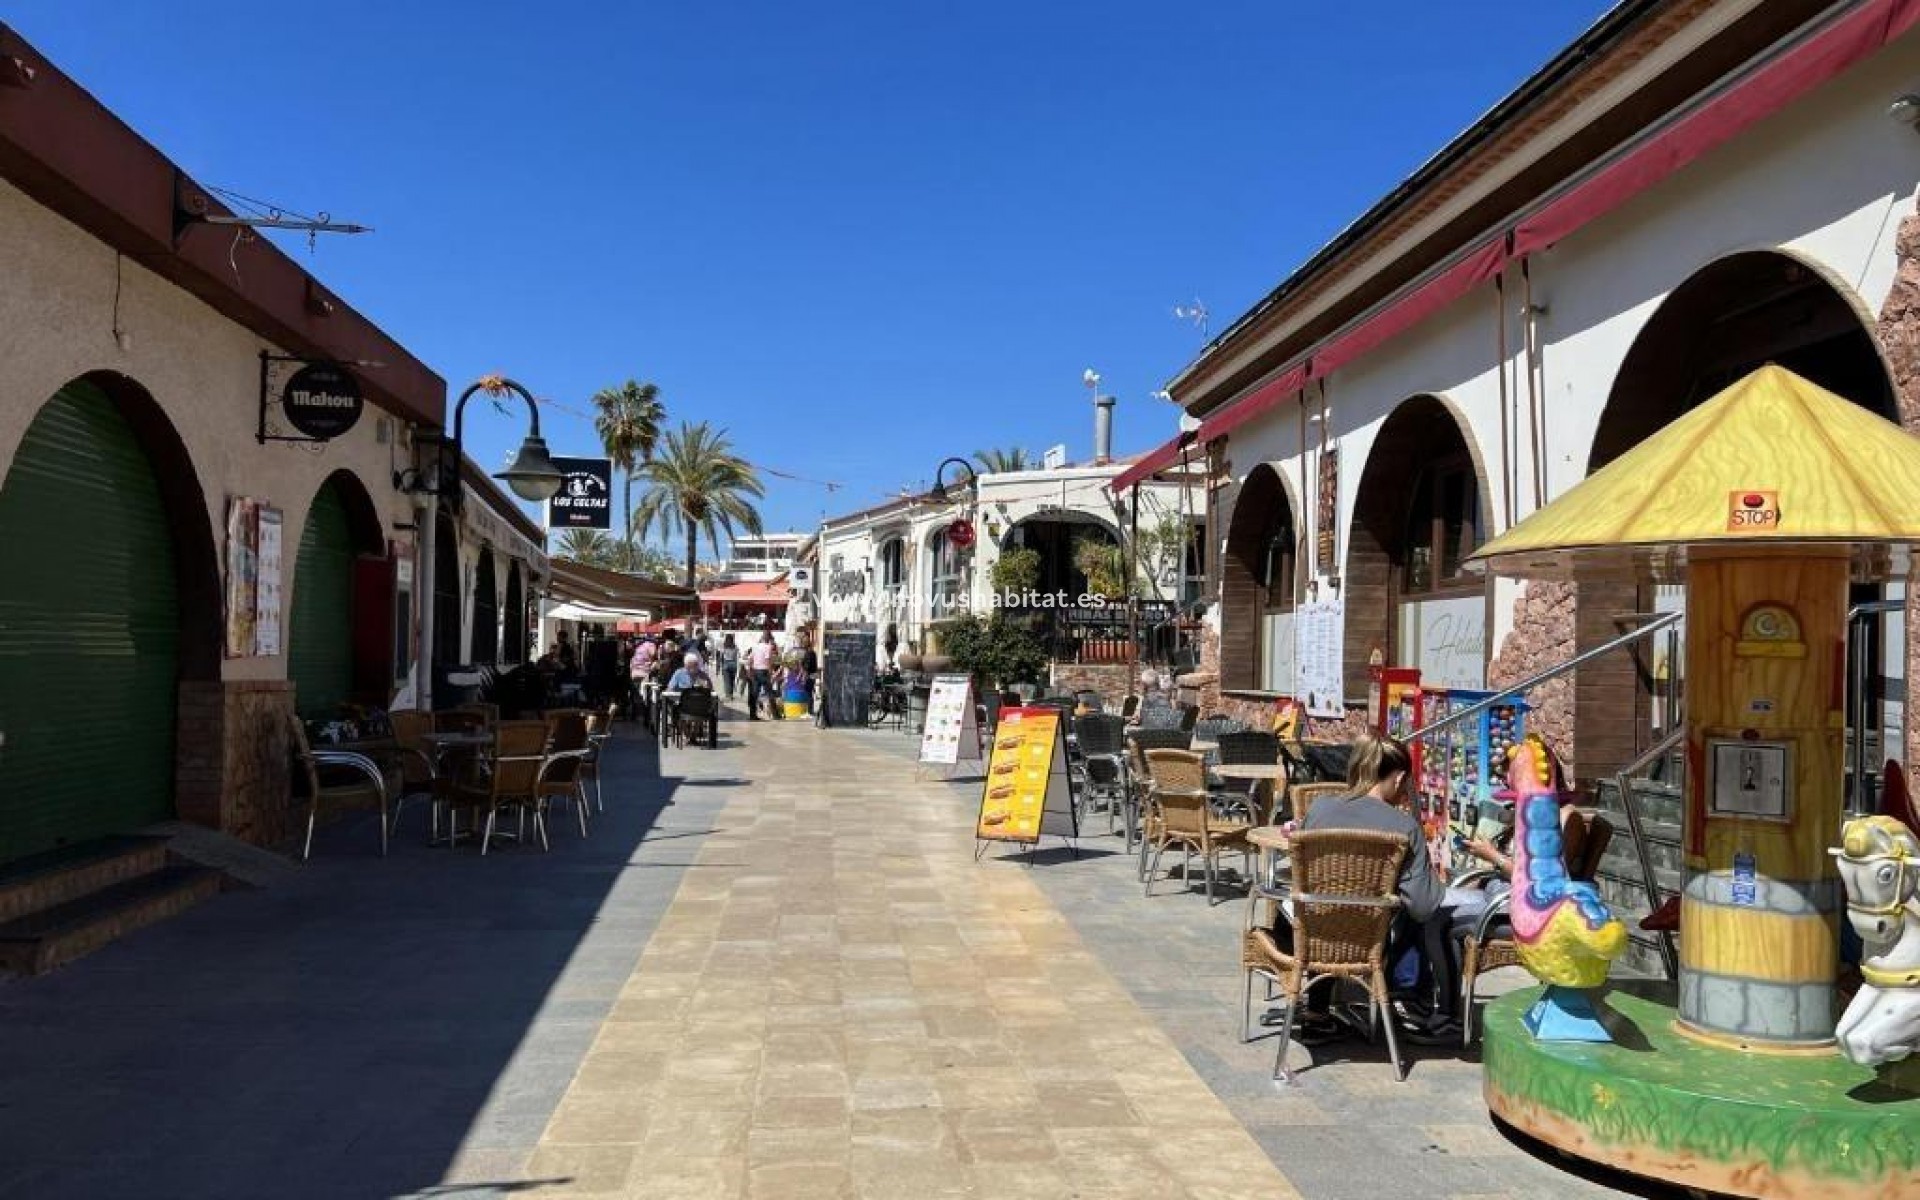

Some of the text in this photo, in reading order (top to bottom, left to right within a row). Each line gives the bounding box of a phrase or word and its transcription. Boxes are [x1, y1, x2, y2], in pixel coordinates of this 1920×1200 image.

[291, 390, 355, 408] Mahou
[553, 496, 608, 508] LOS CELTAS
[1731, 509, 1775, 526] STOP
